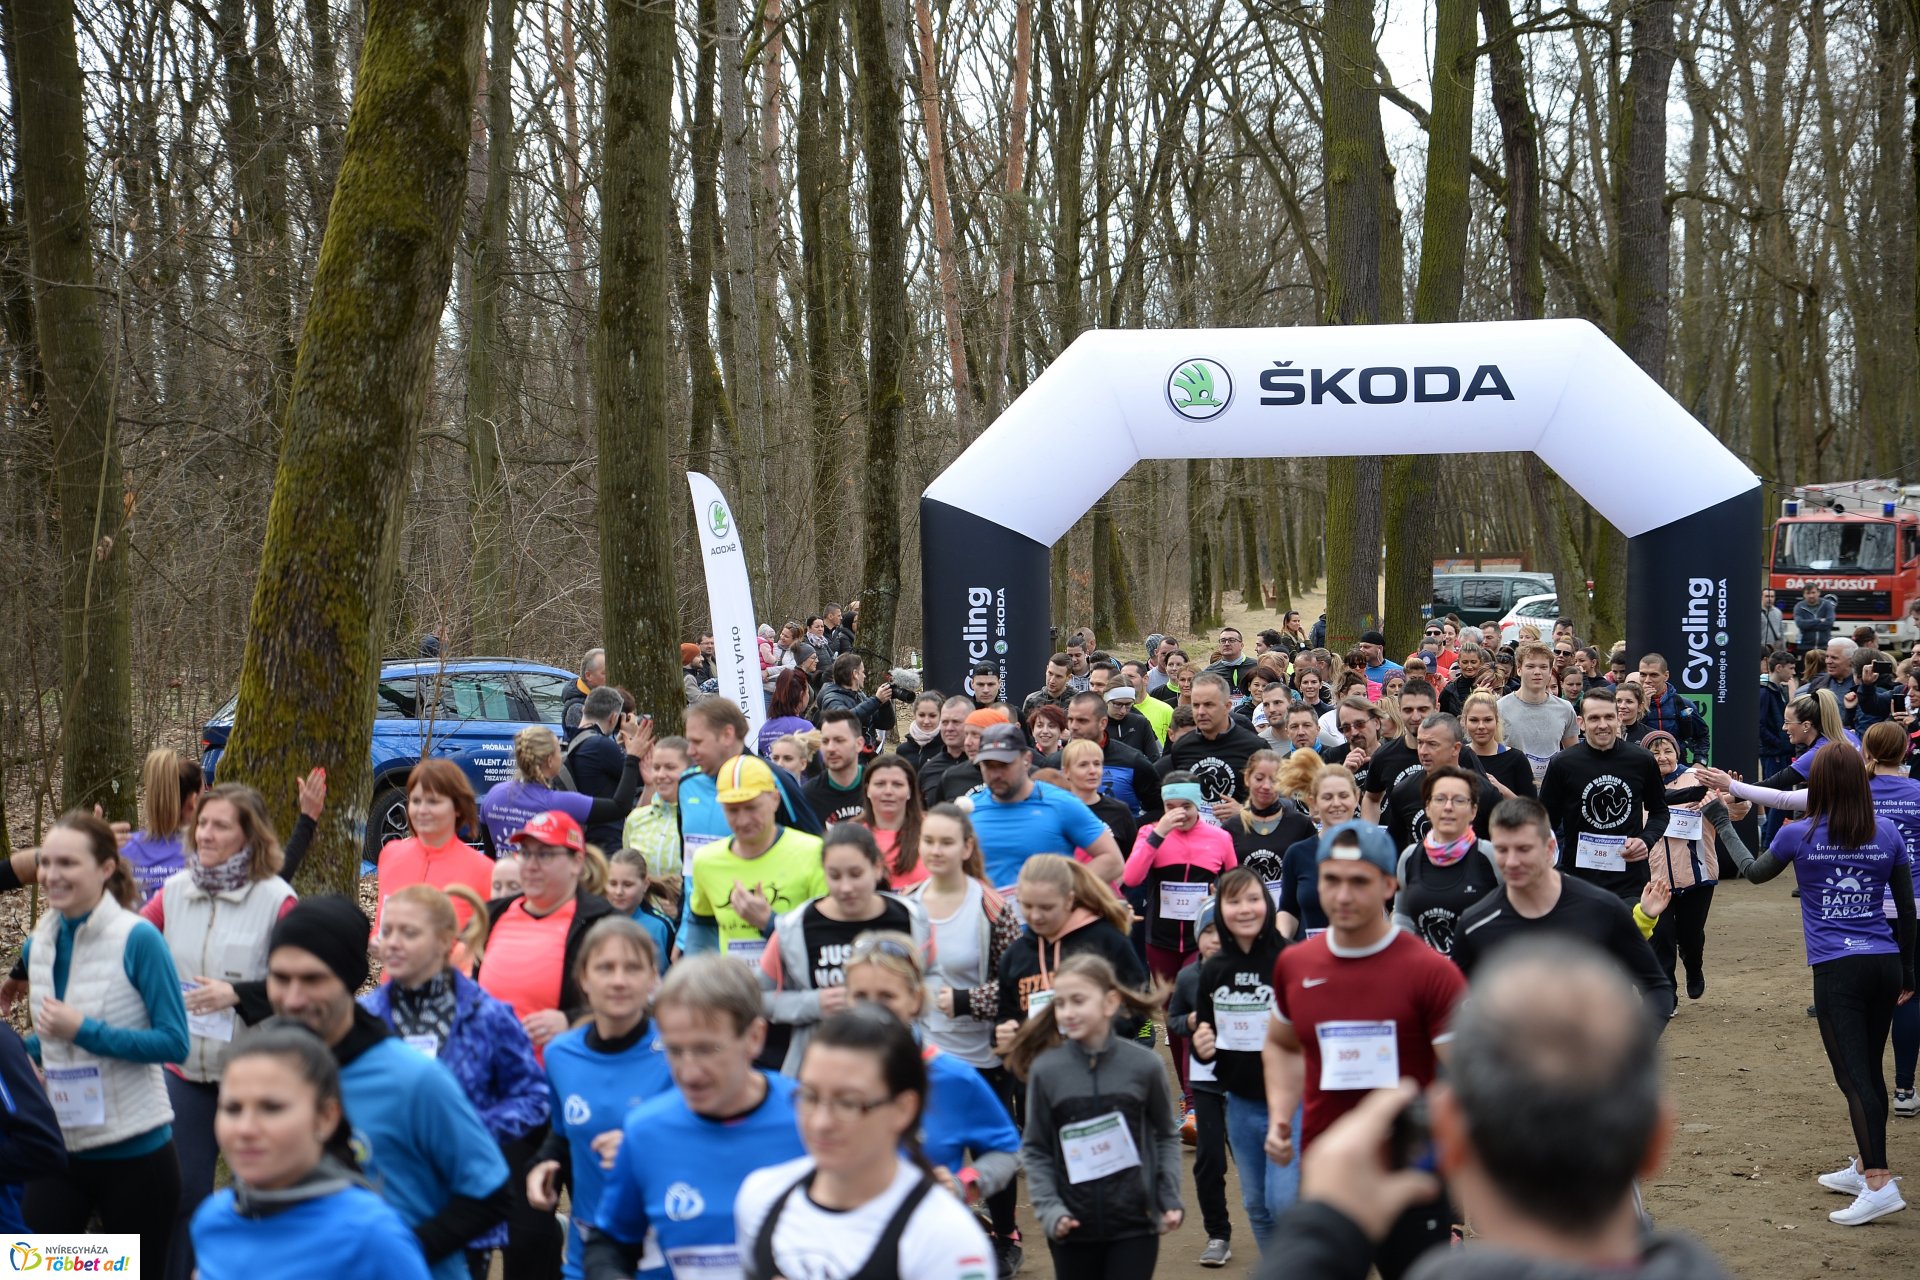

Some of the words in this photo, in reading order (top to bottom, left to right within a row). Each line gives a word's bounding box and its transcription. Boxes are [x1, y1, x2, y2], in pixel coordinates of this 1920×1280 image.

[1260, 360, 1515, 406] ŠKODA
[1716, 578, 1728, 628] ŠKODA
[995, 587, 1006, 637] ŠKODA
[1681, 577, 1714, 690] Cycling
[997, 664, 1008, 704] ajtóereje
[1717, 657, 1728, 703] Hajtóereje
[473, 758, 502, 767] VALENT
[501, 759, 517, 767] AUT
[1592, 774, 1622, 785] WARRIOR
[1621, 781, 1633, 798] TEAM
[1879, 807, 1904, 815] sportoló
[1593, 848, 1608, 858] 288
[1816, 842, 1826, 851] Én
[1807, 853, 1837, 862] Jótékony
[1837, 853, 1865, 861] sportoló
[1865, 852, 1890, 861] vagyok.
[1176, 898, 1190, 906] 212
[1822, 892, 1872, 907] BÁTOR
[1821, 904, 1871, 918] TÁBOR
[817, 943, 853, 967] JUS
[1234, 971, 1263, 987] REAL
